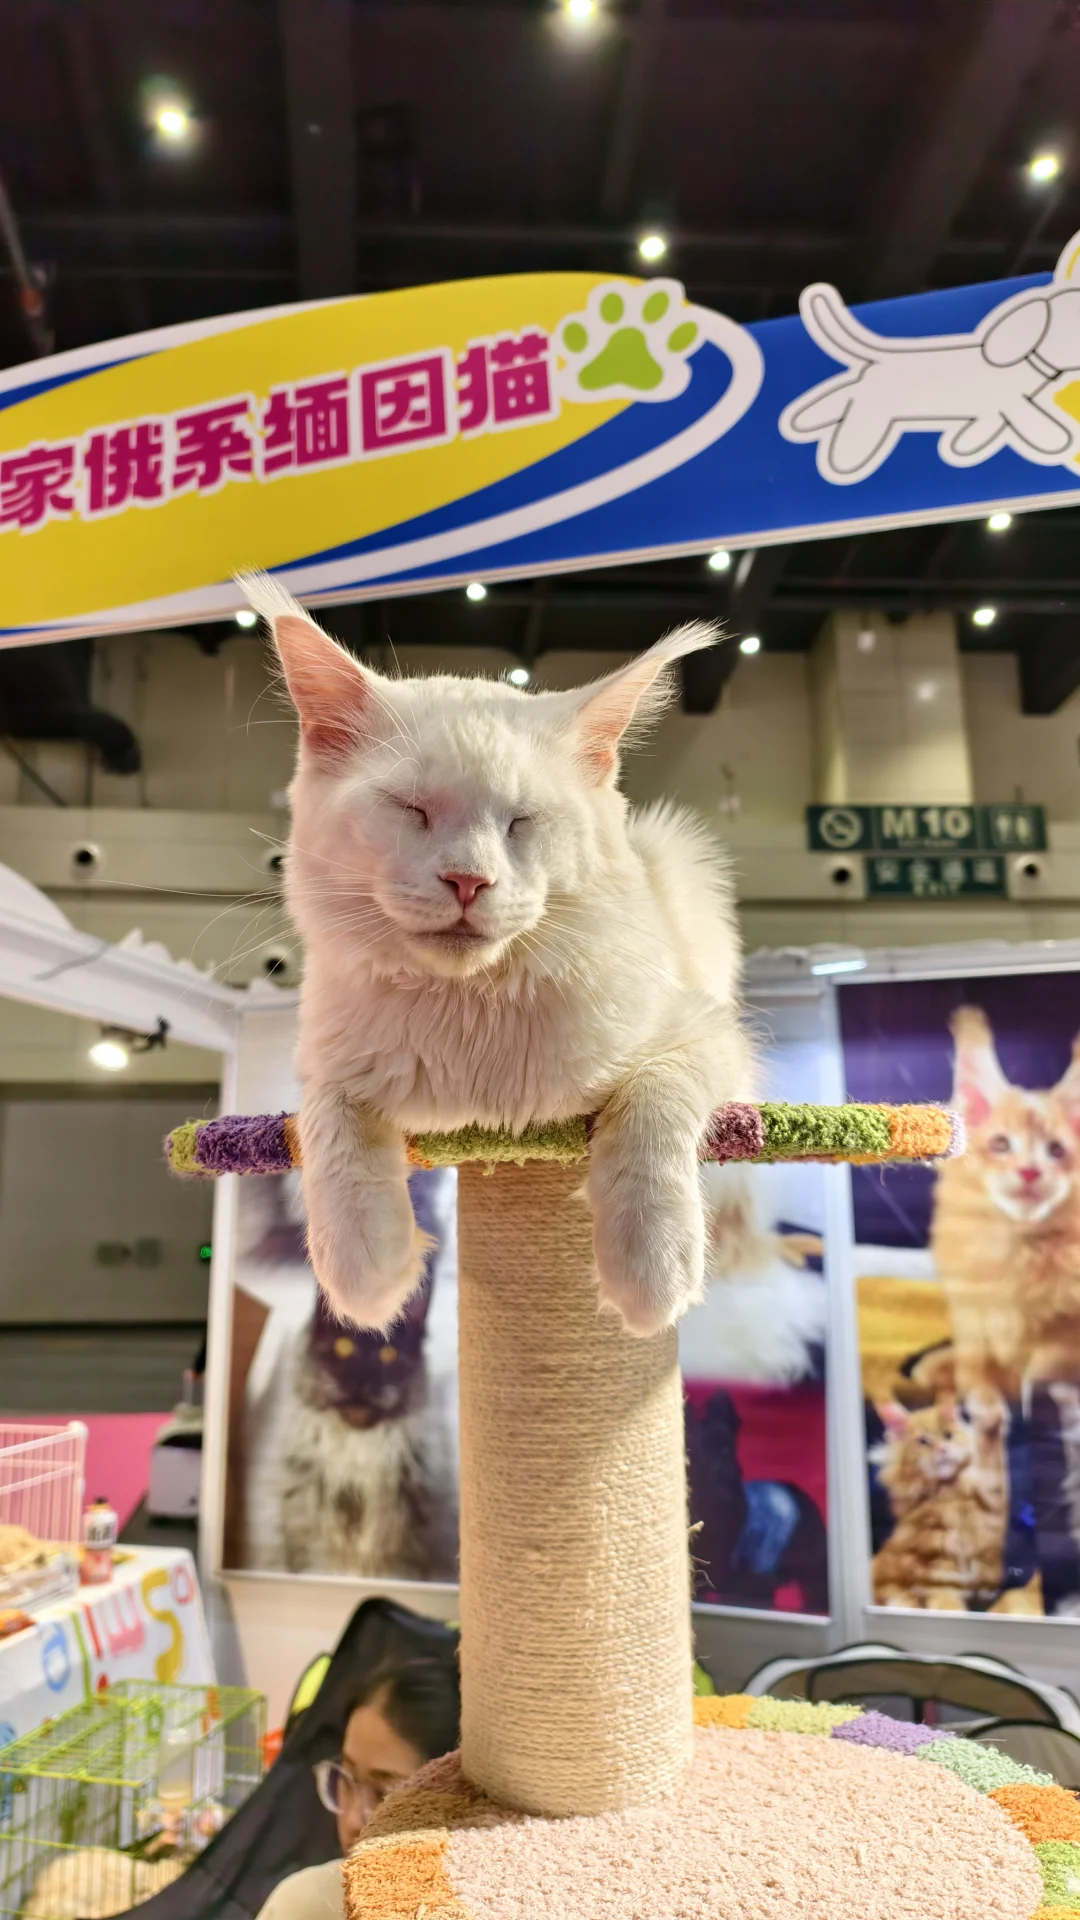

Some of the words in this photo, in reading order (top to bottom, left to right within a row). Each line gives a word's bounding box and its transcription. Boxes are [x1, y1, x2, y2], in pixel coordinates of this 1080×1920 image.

[0, 332, 552, 529] 家俄系缅因猫
[881, 808, 971, 839] M10
